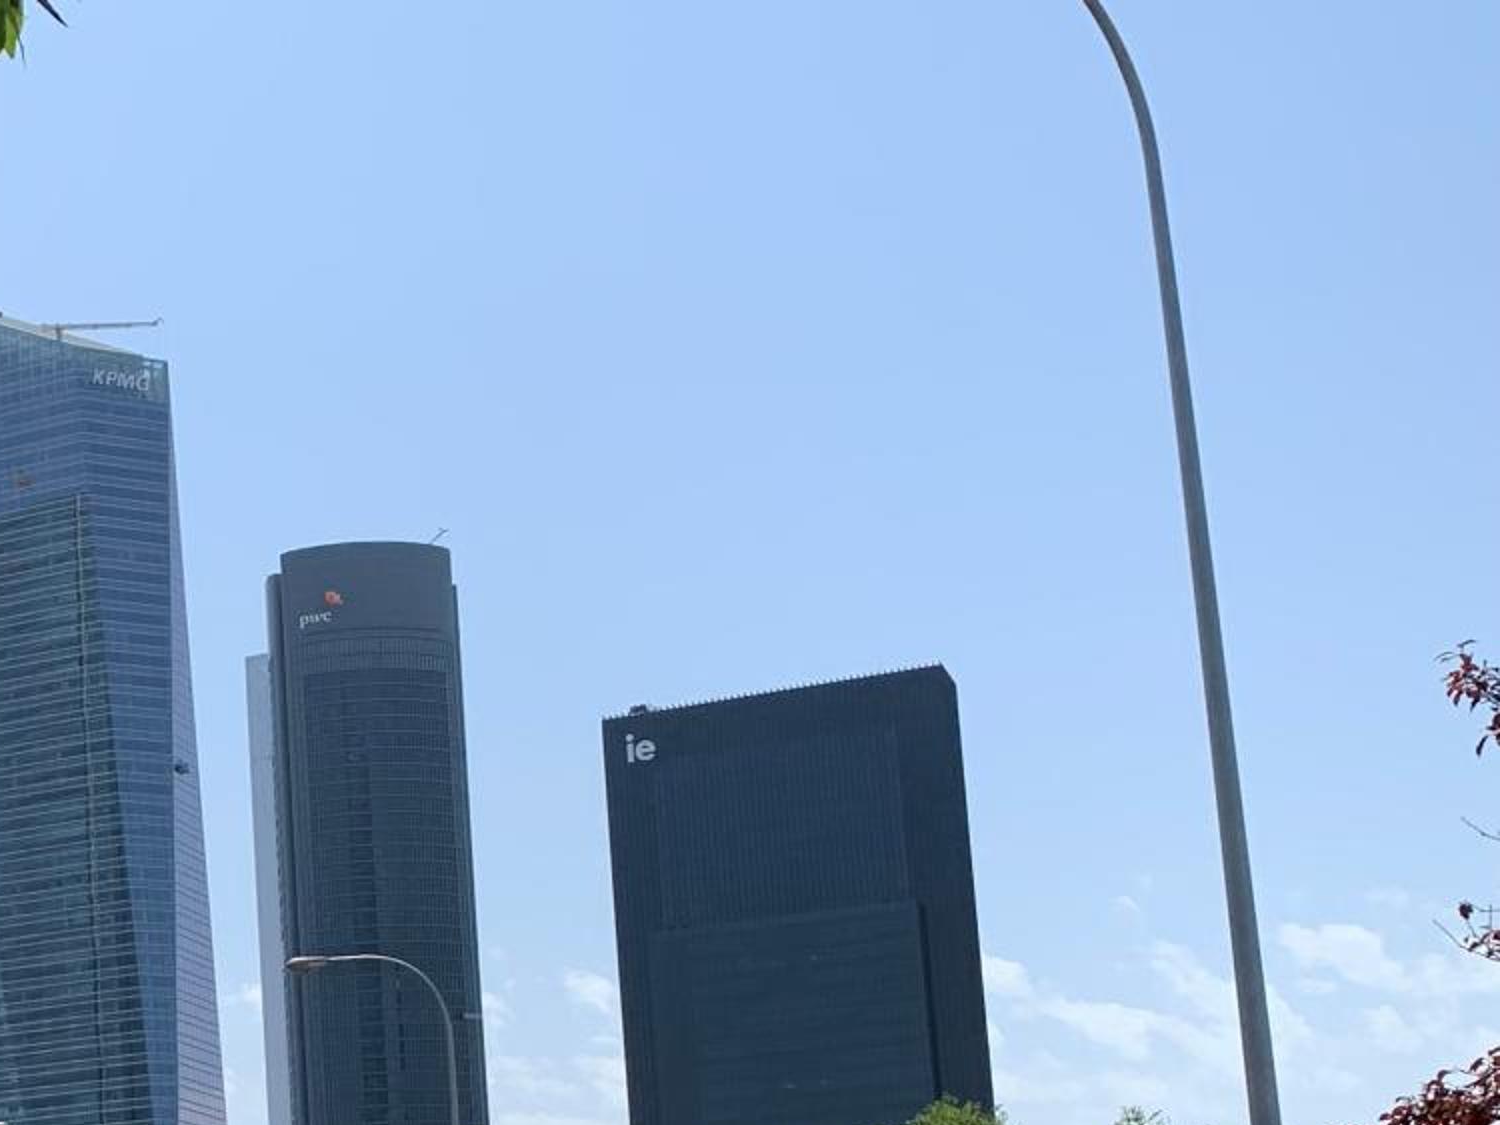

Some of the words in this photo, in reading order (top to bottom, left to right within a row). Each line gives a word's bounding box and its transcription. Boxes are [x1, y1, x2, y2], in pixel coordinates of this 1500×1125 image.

[92, 367, 150, 391] KPMG
[299, 611, 332, 629] pwc
[625, 733, 656, 763] ie
